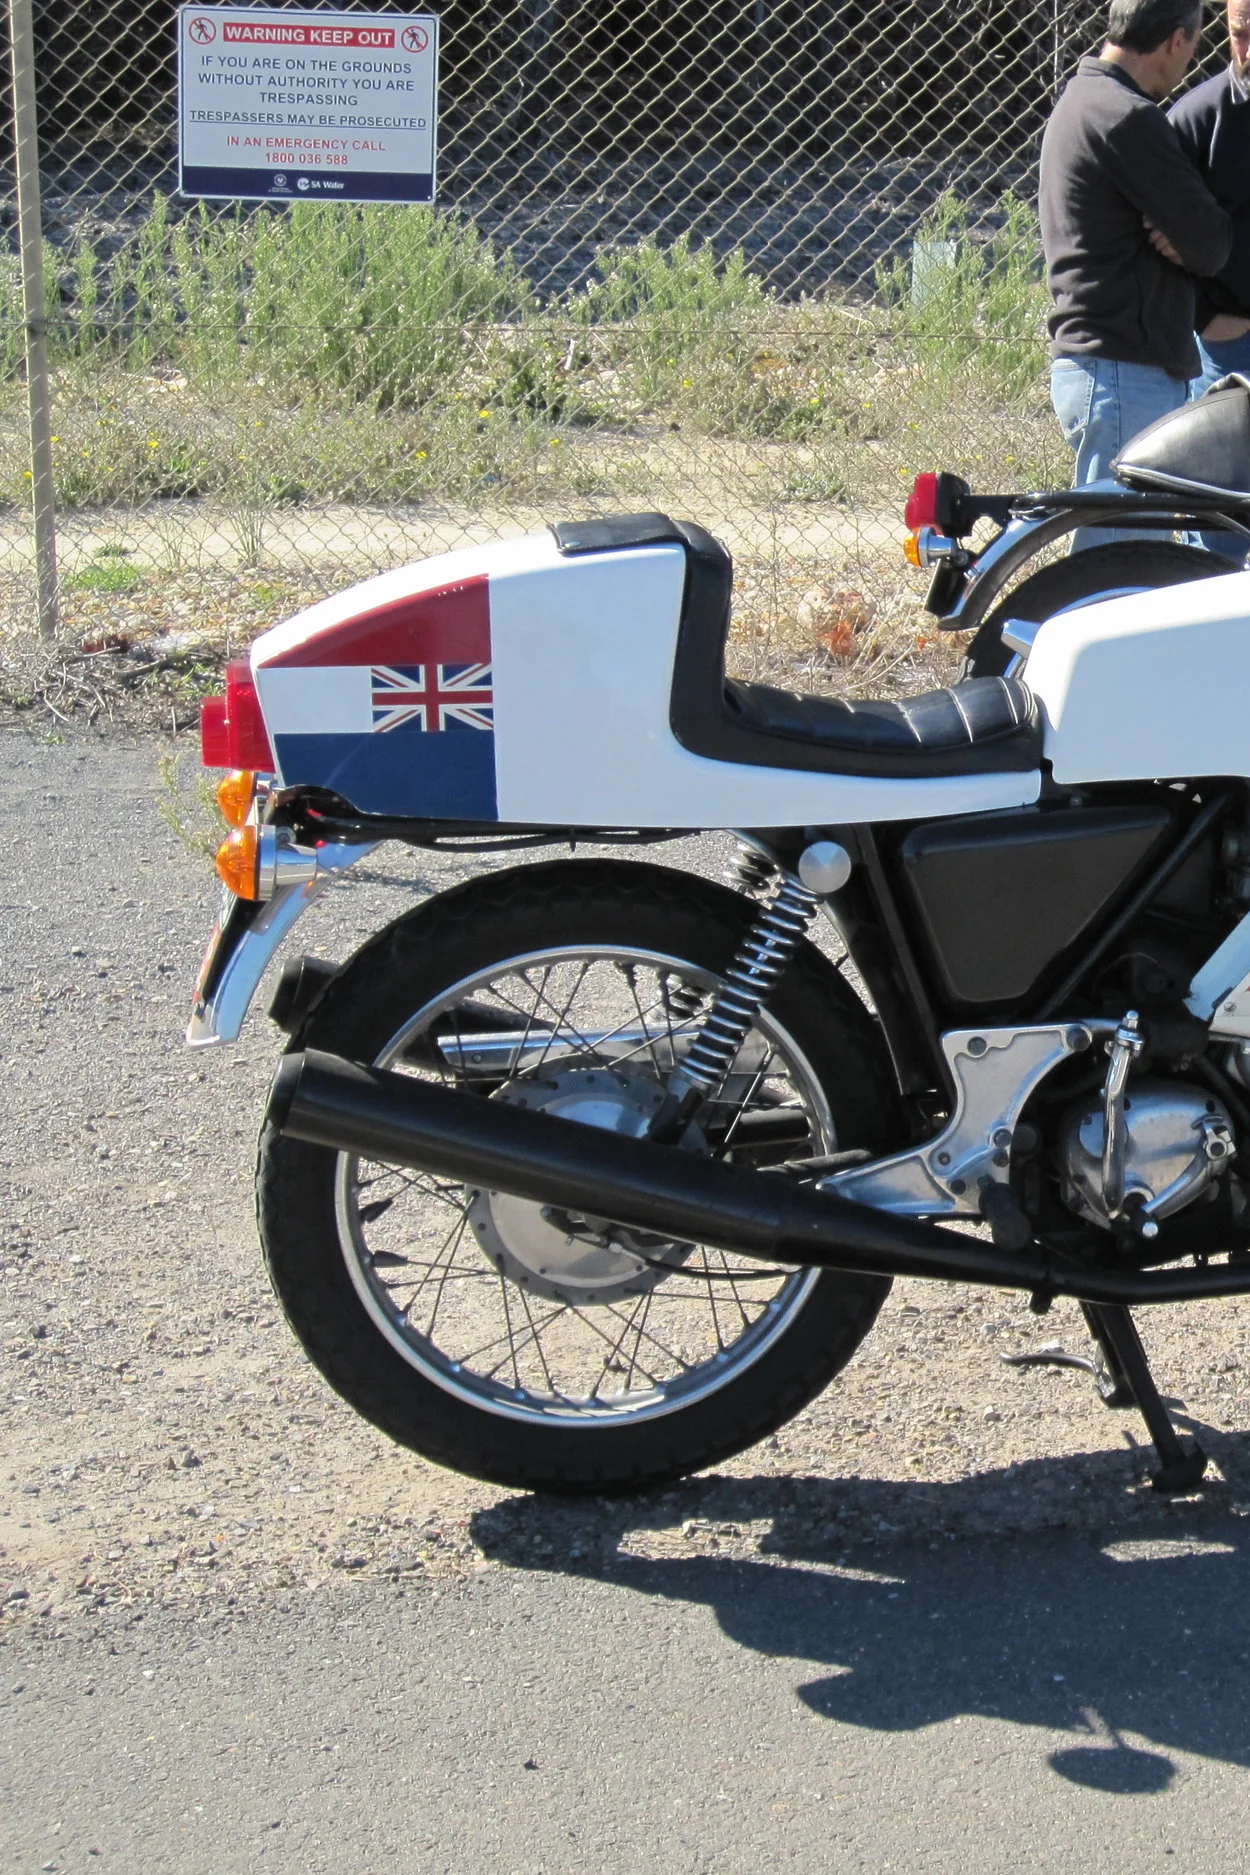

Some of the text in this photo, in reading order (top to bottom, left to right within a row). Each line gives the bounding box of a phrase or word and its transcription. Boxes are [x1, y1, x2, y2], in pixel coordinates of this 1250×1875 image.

[226, 25, 392, 46] WARNING KEEP OUT
[201, 55, 412, 75] IF YOU ARE ON THE GROUNDS
[198, 73, 415, 92] WITHOUT AUTHORITY YOU ARE
[260, 92, 358, 106] TRESPASSING
[190, 110, 427, 129] TRESPASSERS MAY BE PROSECUTED
[226, 136, 386, 152] IN AN EMERGENCY CALL
[265, 152, 348, 165] 1800 036 588
[311, 181, 345, 189] SA Water
